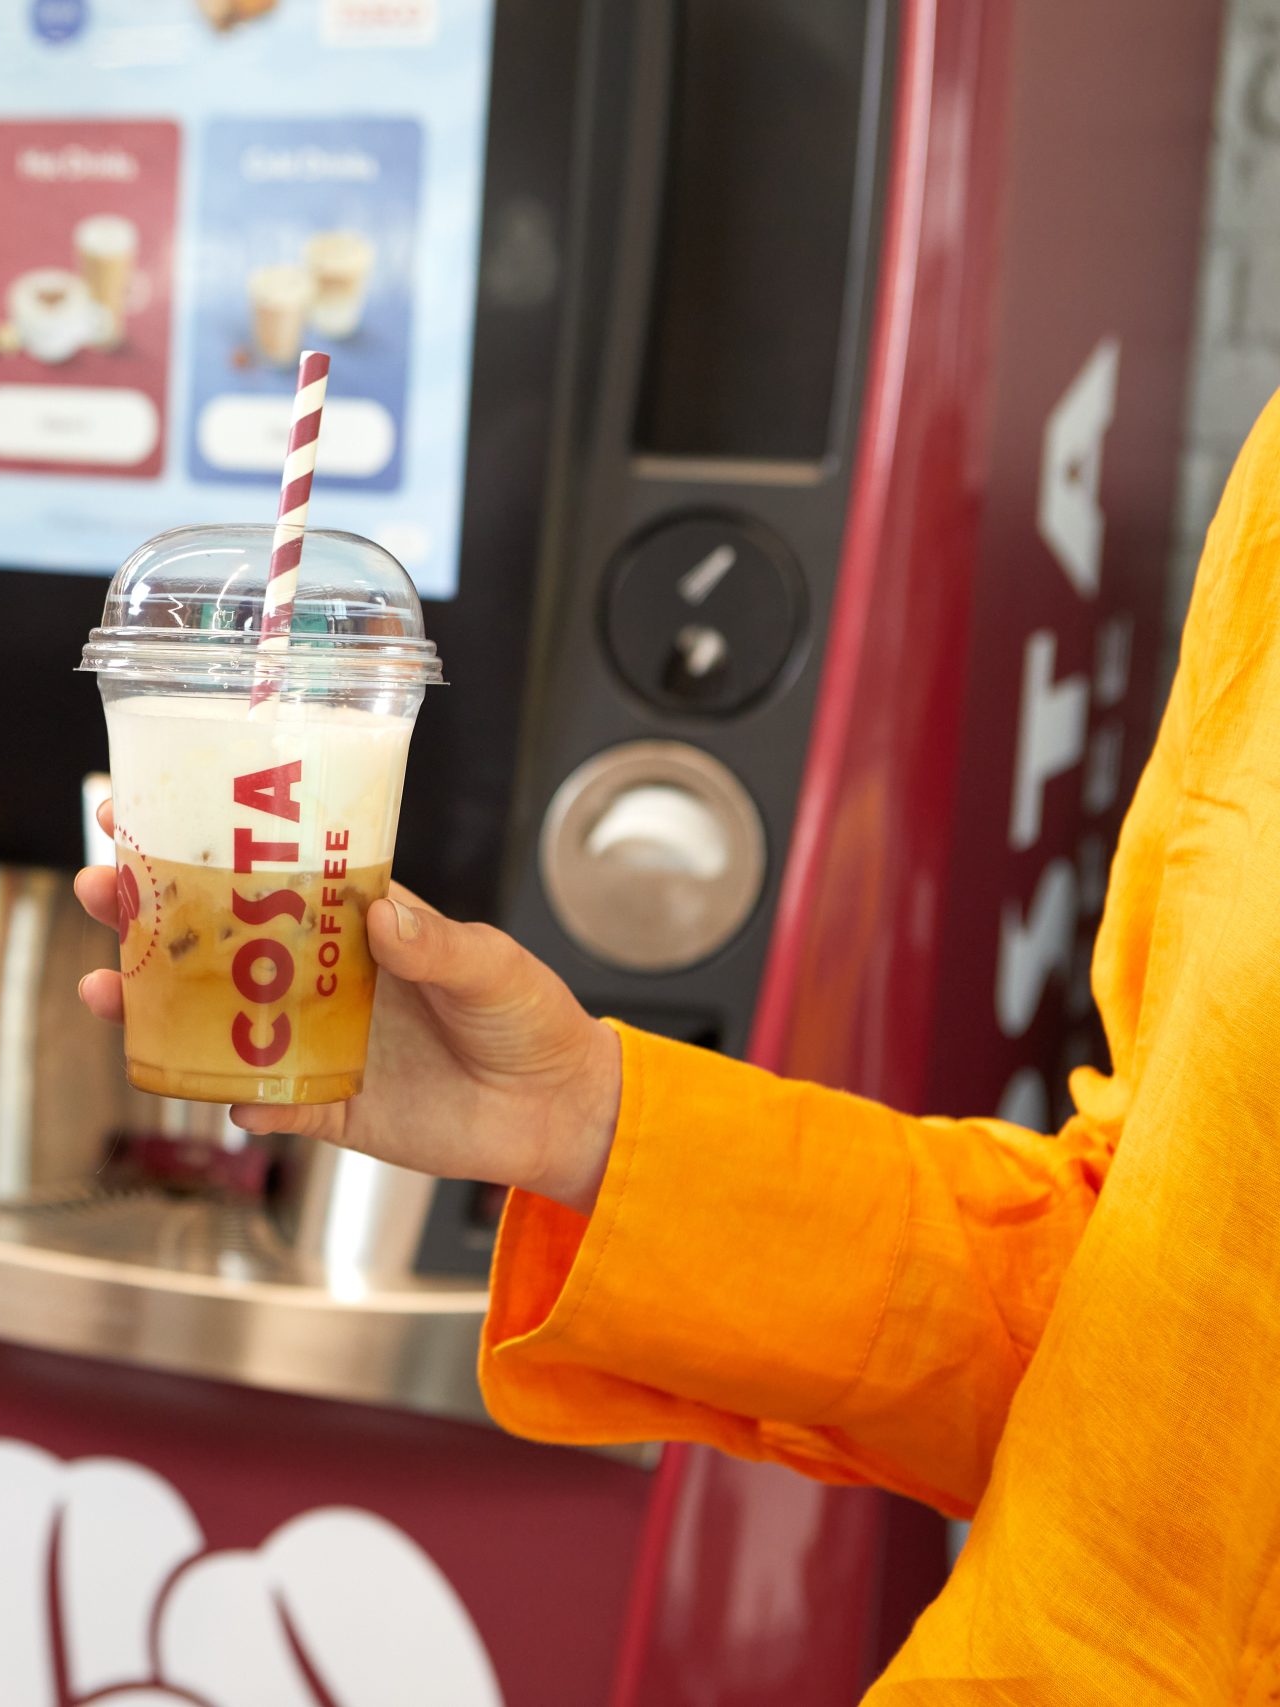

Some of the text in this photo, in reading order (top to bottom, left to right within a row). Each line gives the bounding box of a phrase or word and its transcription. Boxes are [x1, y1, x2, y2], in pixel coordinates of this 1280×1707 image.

[995, 337, 1122, 1134] STA
[231, 759, 307, 1068] COSTA
[316, 828, 350, 998] COFFEE
